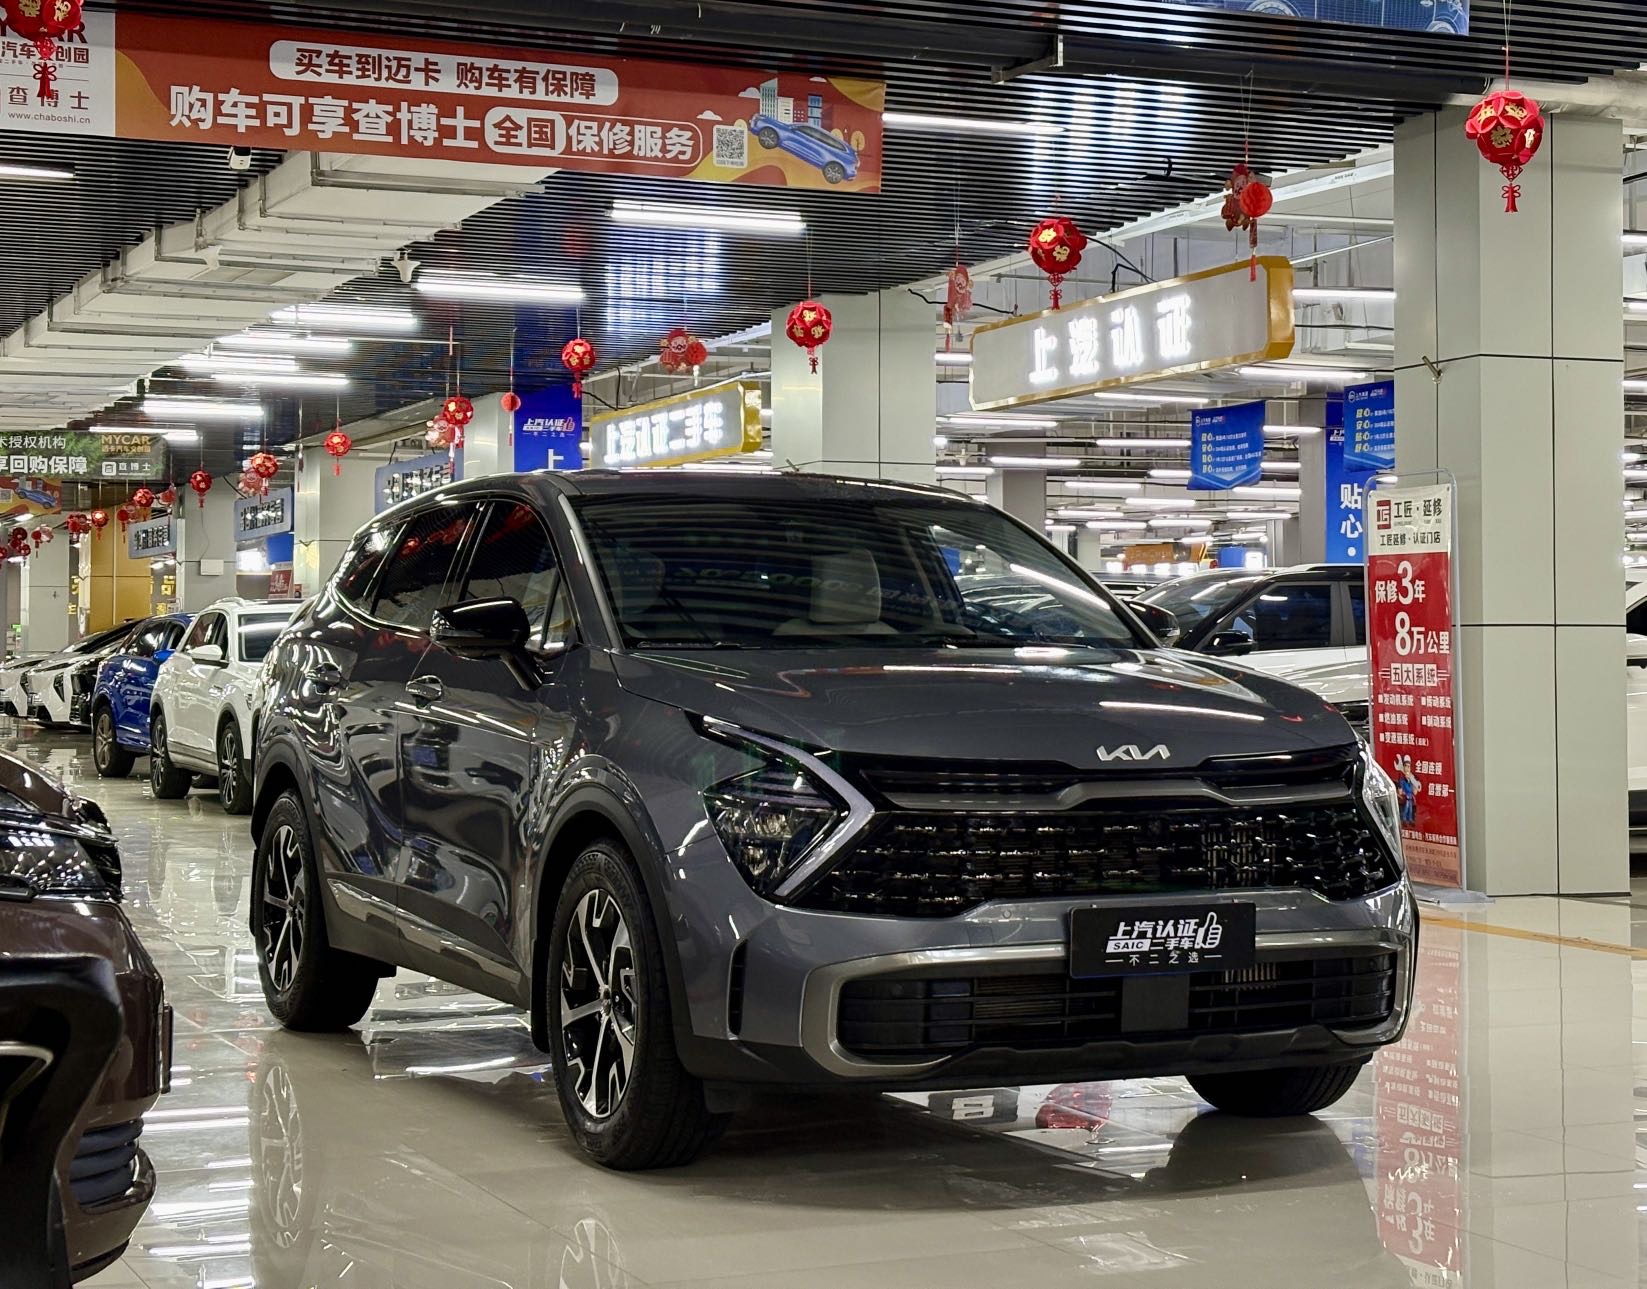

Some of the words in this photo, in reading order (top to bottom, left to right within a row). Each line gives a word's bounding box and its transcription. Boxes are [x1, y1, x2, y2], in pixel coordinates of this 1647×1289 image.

[1, 41, 89, 64] 汽车创园
[294, 48, 442, 87] 买车到迈卡
[455, 61, 597, 100] 购车有保障
[8, 112, 91, 124] www.chaboshi.cn
[101, 434, 151, 445] MYCAR
[1391, 665, 1437, 685] 五大系统
[1096, 744, 1171, 761] KIA
[1108, 918, 1200, 940] 上汽认证
[1113, 942, 1144, 951] SAIC
[1149, 937, 1195, 950] 二手车
[1128, 950, 1199, 966] 不二之选
